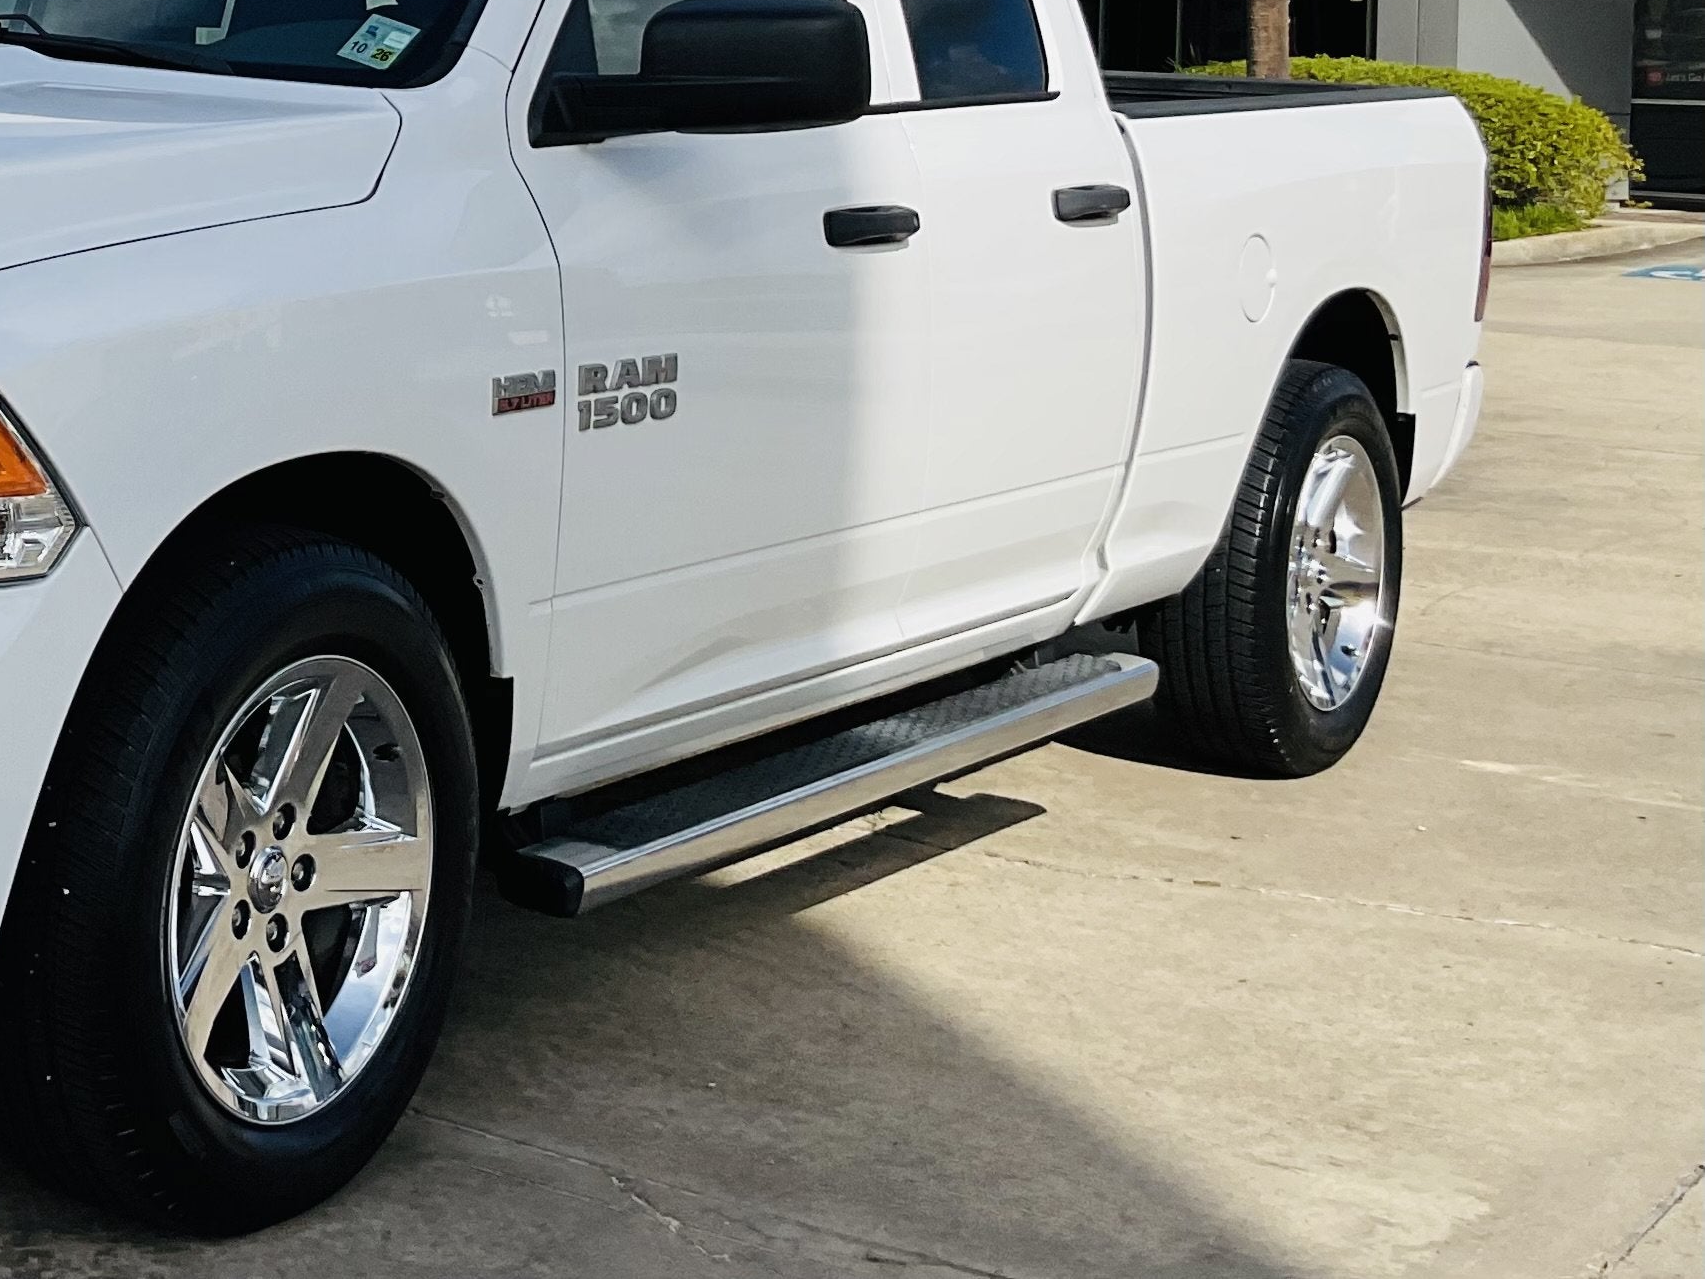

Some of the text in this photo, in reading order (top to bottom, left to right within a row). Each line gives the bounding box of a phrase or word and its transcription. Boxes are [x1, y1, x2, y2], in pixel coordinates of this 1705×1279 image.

[350, 40, 393, 62] 10 26
[578, 353, 678, 396] RAM
[578, 388, 677, 432] 1500
